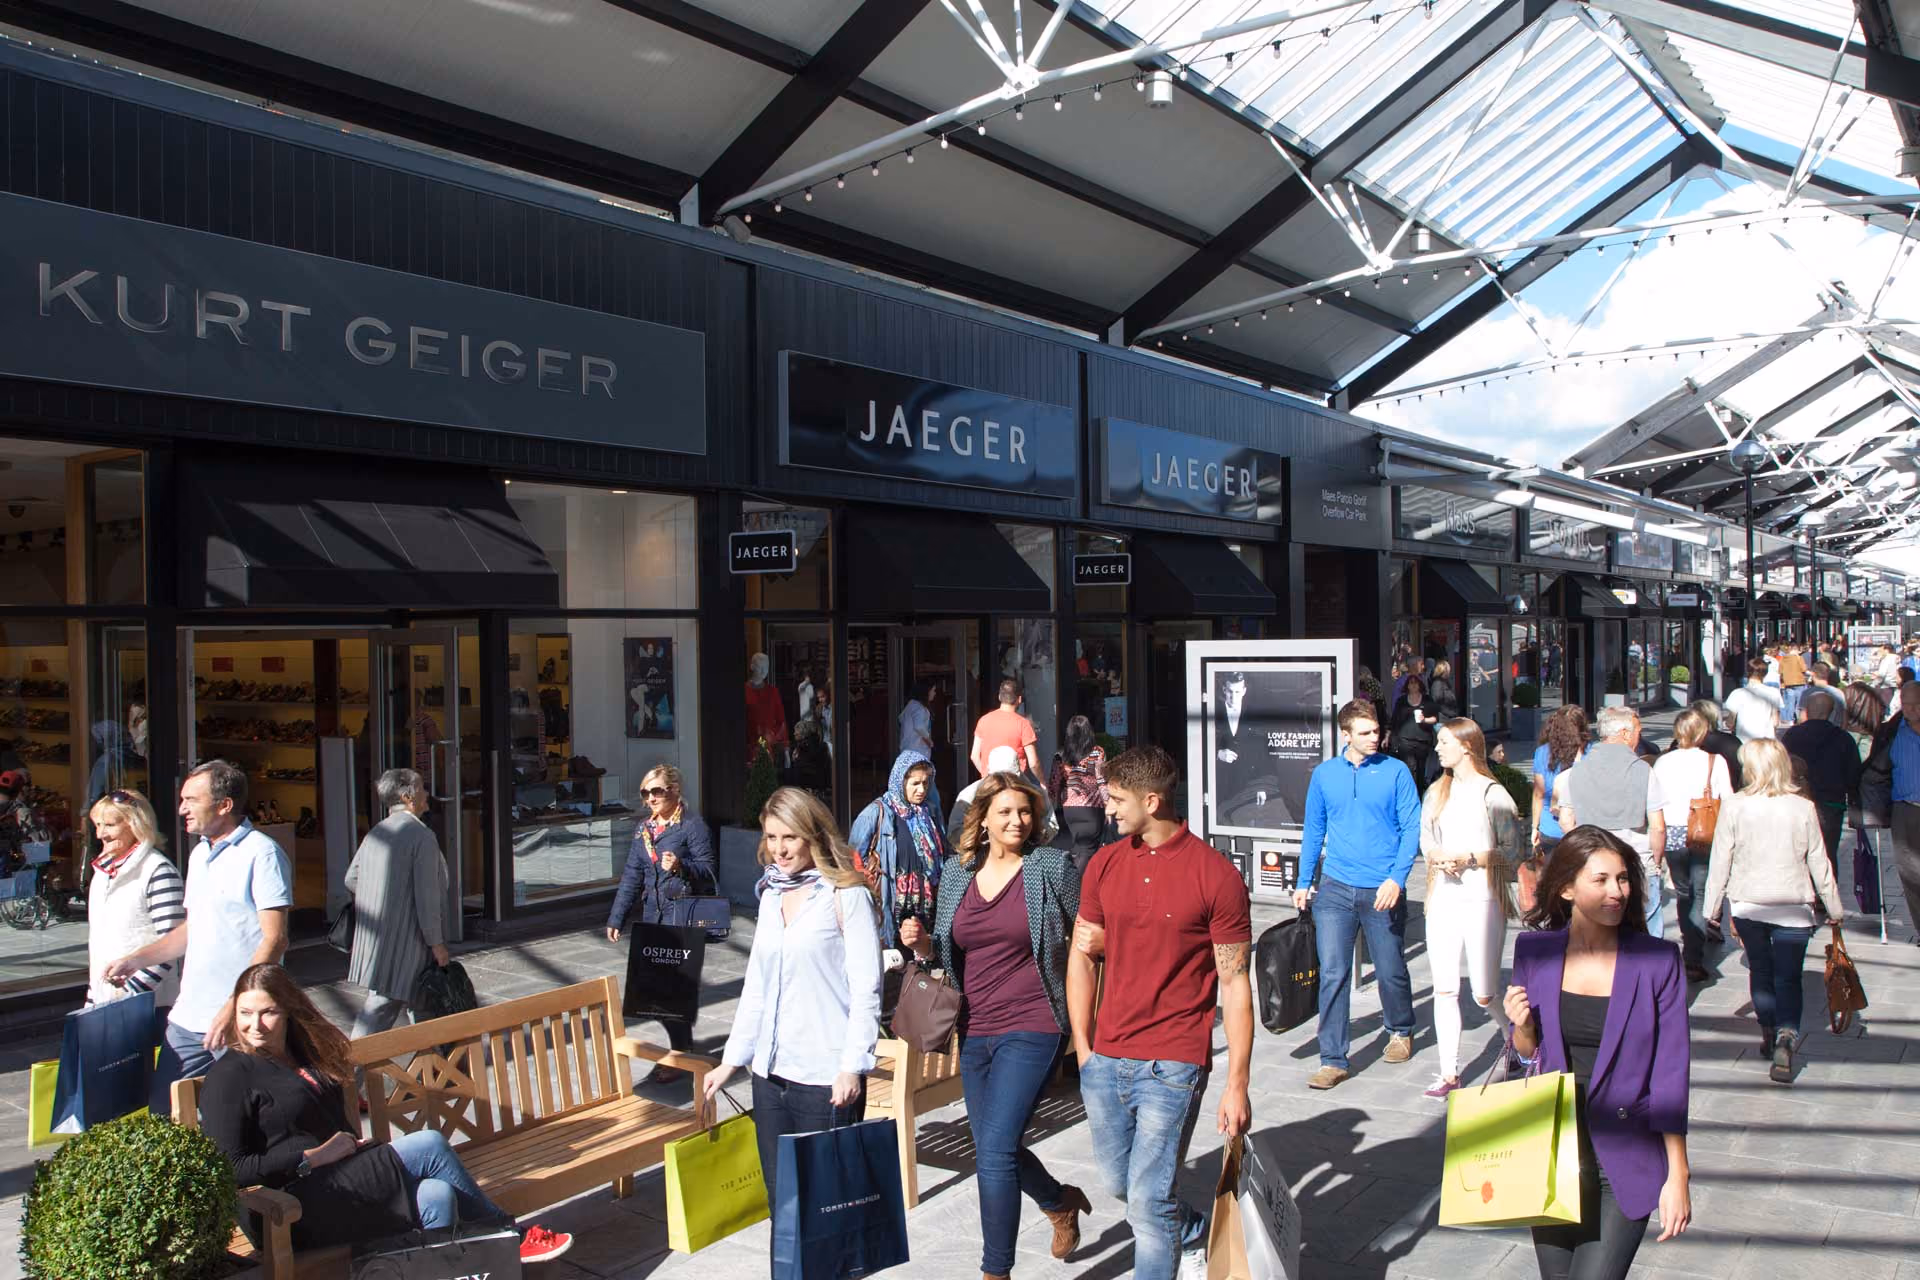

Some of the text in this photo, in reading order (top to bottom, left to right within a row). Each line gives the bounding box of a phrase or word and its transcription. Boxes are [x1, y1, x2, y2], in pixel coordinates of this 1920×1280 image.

[39, 262, 618, 400] KURT GEIGER
[860, 399, 1026, 465] JAEGER
[1151, 452, 1252, 499] JAEGER
[736, 545, 788, 559] JAEGER
[1079, 564, 1125, 575] JAEGER
[1267, 732, 1321, 740] LOVE FASHION
[1267, 740, 1321, 748] ADORE LIFE
[642, 946, 692, 960] OSPREY
[651, 957, 681, 965] LONDON
